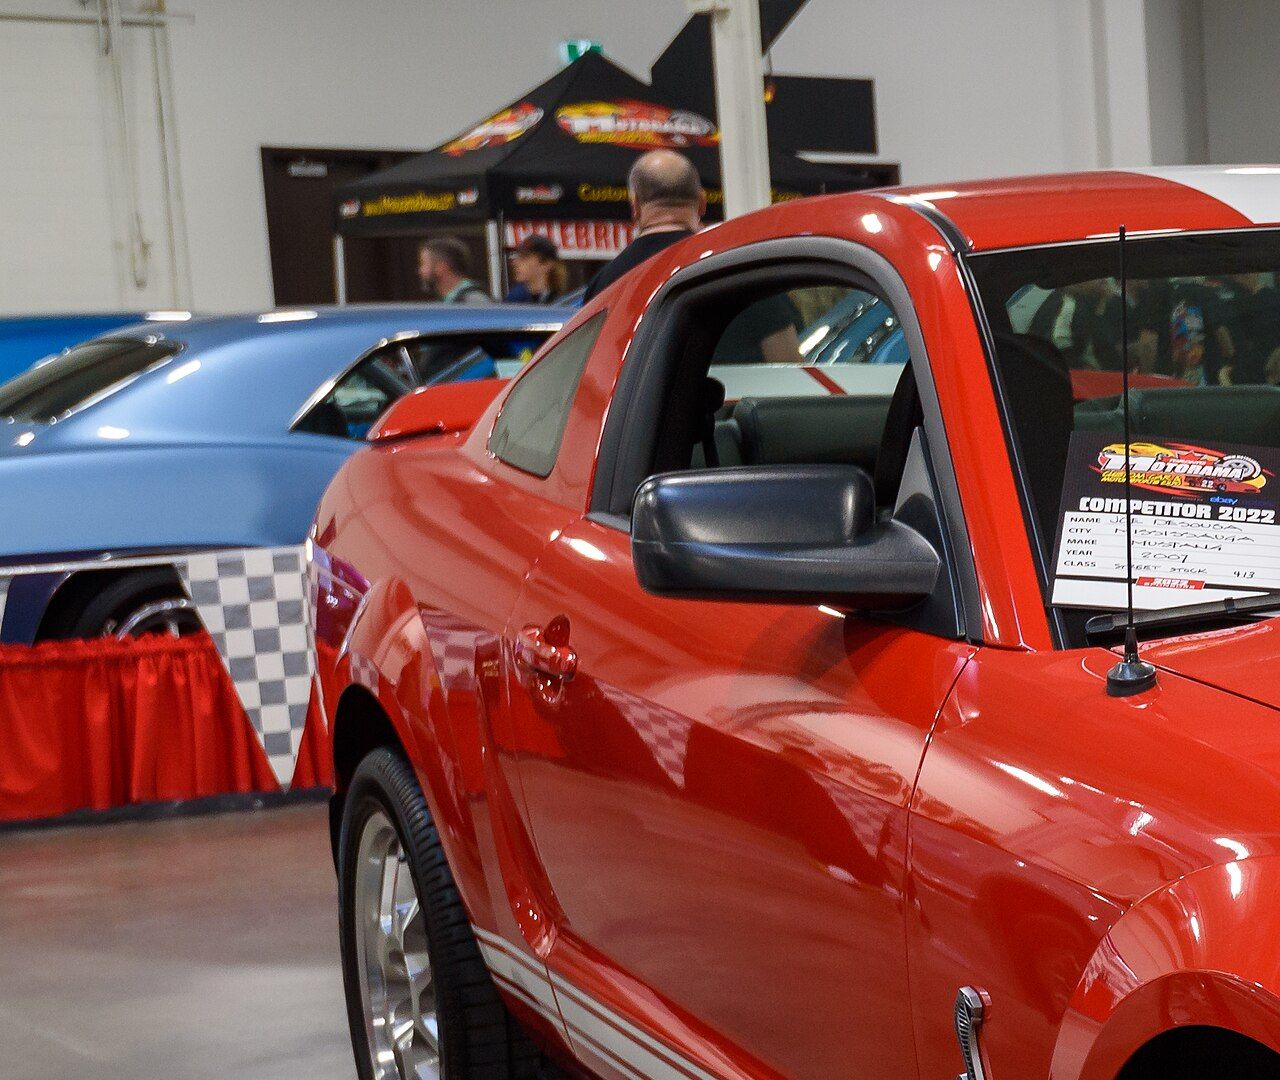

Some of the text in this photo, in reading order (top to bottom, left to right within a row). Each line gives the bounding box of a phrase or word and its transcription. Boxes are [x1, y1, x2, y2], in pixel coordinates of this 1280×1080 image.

[1209, 496, 1239, 506] ebay
[1079, 496, 1276, 524] COMPETITOR 2022
[1141, 551, 1189, 564] 2007
[1063, 560, 1097, 568] CLASS
[1233, 570, 1256, 579] 413
